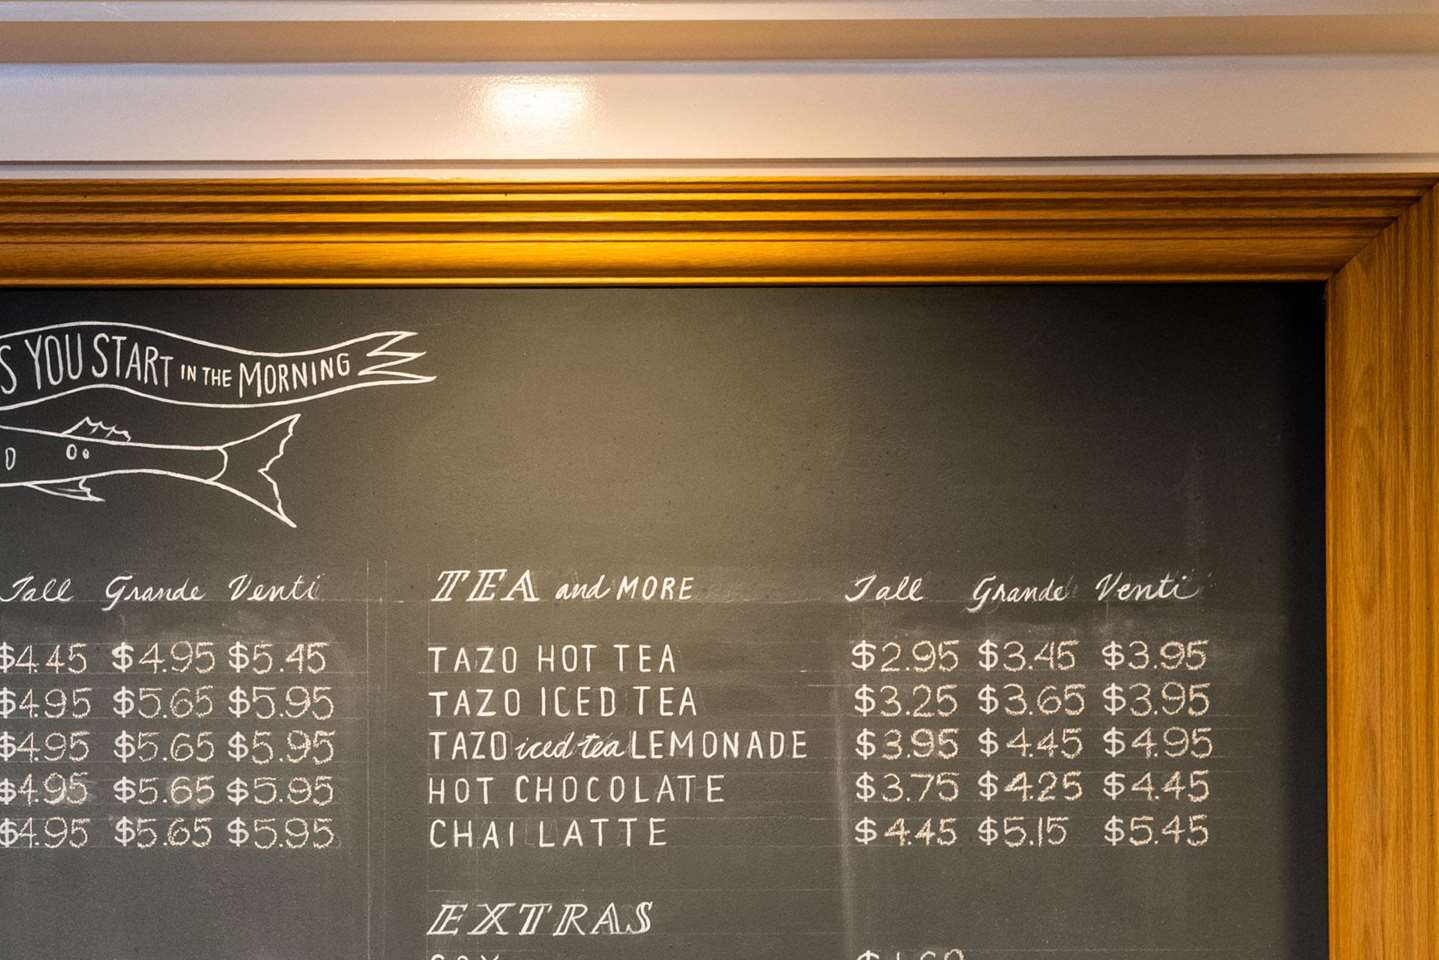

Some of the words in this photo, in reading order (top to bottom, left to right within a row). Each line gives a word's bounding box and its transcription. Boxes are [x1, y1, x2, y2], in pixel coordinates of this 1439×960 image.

[25, 334, 86, 393] YOU
[88, 329, 177, 390] START
[181, 365, 196, 381] IN
[202, 367, 232, 387] THE
[235, 350, 353, 401] MORNING
[431, 569, 540, 602] TEA
[617, 576, 694, 600] MORE
[112, 641, 215, 673] $4.95
[228, 641, 328, 674] $5.45
[428, 646, 517, 673] TAZO
[538, 644, 597, 672] HOT
[614, 644, 675, 672] TEA
[852, 640, 959, 672] $2.95
[978, 639, 1078, 672] $3.45
[1102, 640, 1208, 670] $3.95
[429, 689, 520, 717] TAZO
[541, 686, 615, 717] ICED
[633, 686, 696, 716] TEA
[429, 731, 506, 760] TAZO
[515, 732, 574, 760] iced
[577, 734, 625, 758] tea
[631, 730, 806, 759] LEMONADE
[429, 777, 493, 804] HOT
[516, 775, 724, 803] CHOCOLATE
[430, 819, 514, 848] CHAI
[539, 818, 666, 847] LATTE
[426, 902, 653, 936] EXTRAS
